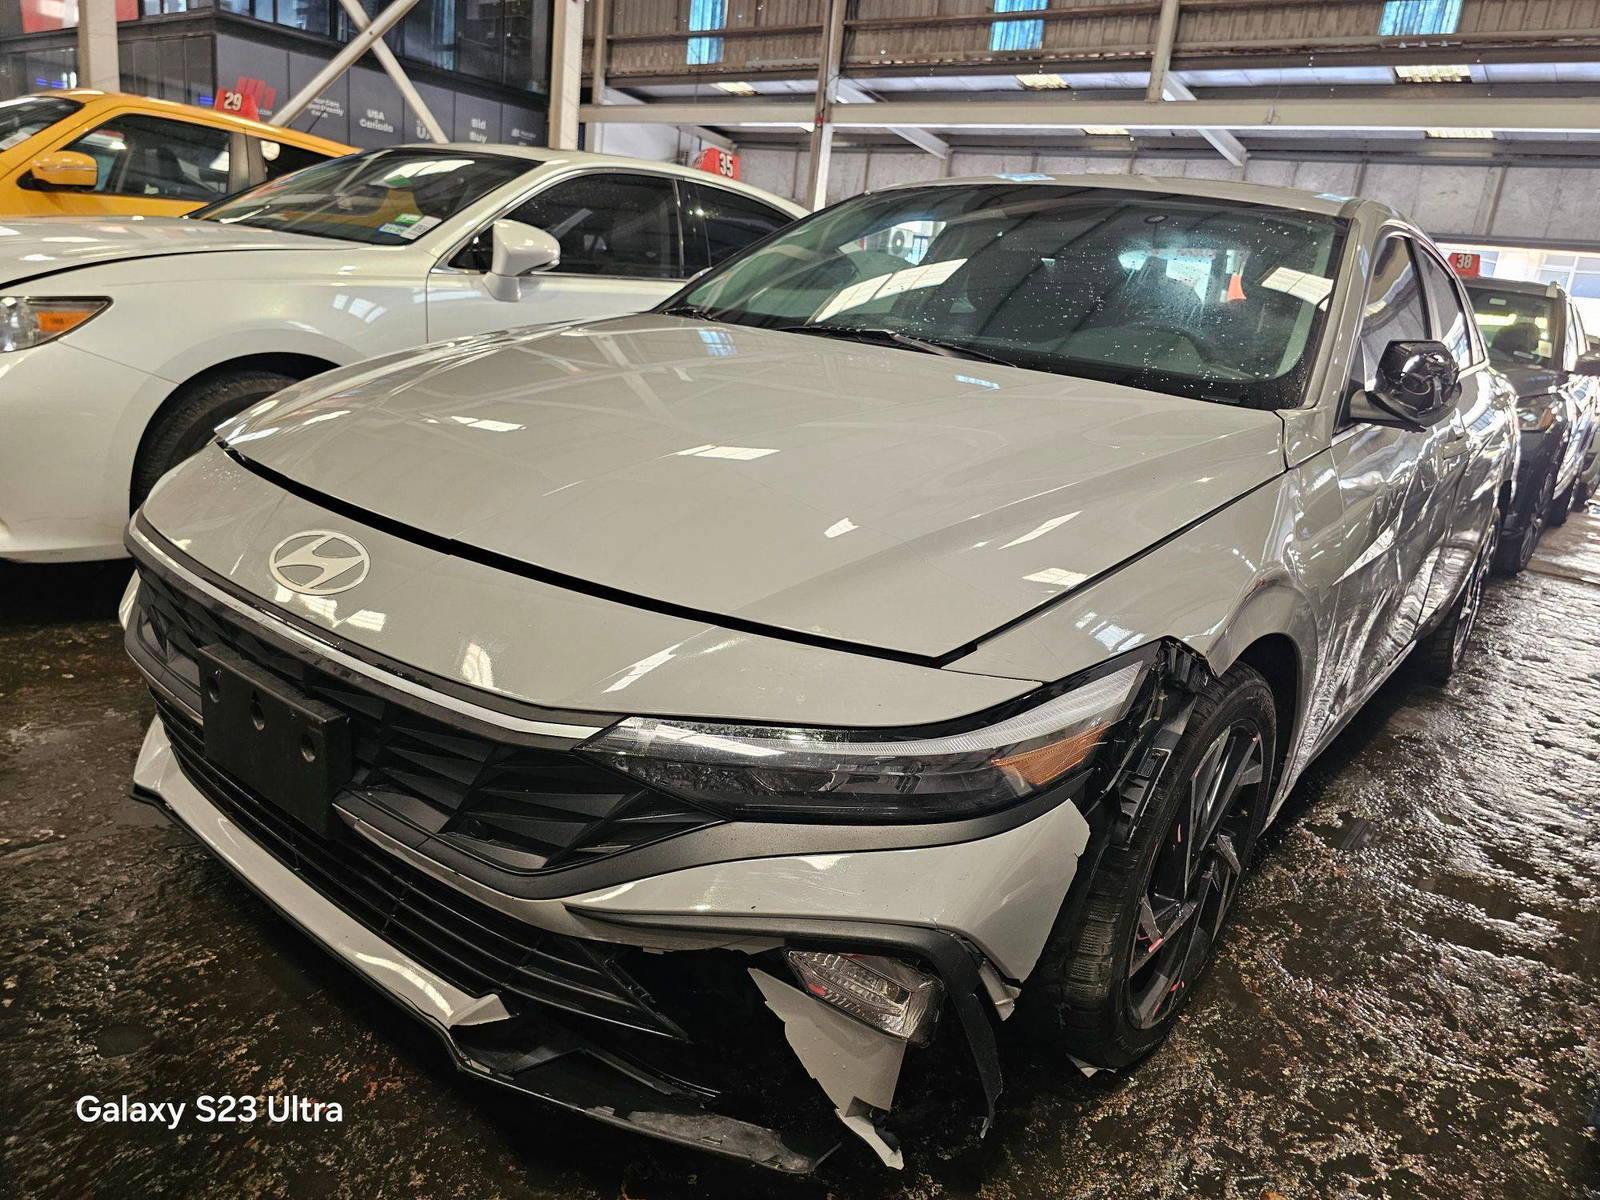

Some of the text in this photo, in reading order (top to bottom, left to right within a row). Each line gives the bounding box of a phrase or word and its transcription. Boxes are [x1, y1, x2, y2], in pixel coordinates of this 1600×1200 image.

[224, 92, 242, 110] 29
[366, 109, 385, 120] USA
[359, 119, 394, 133] Canada
[471, 118, 487, 130] Bid
[469, 131, 487, 144] Buy
[719, 153, 733, 177] 35
[1456, 254, 1472, 268] 38
